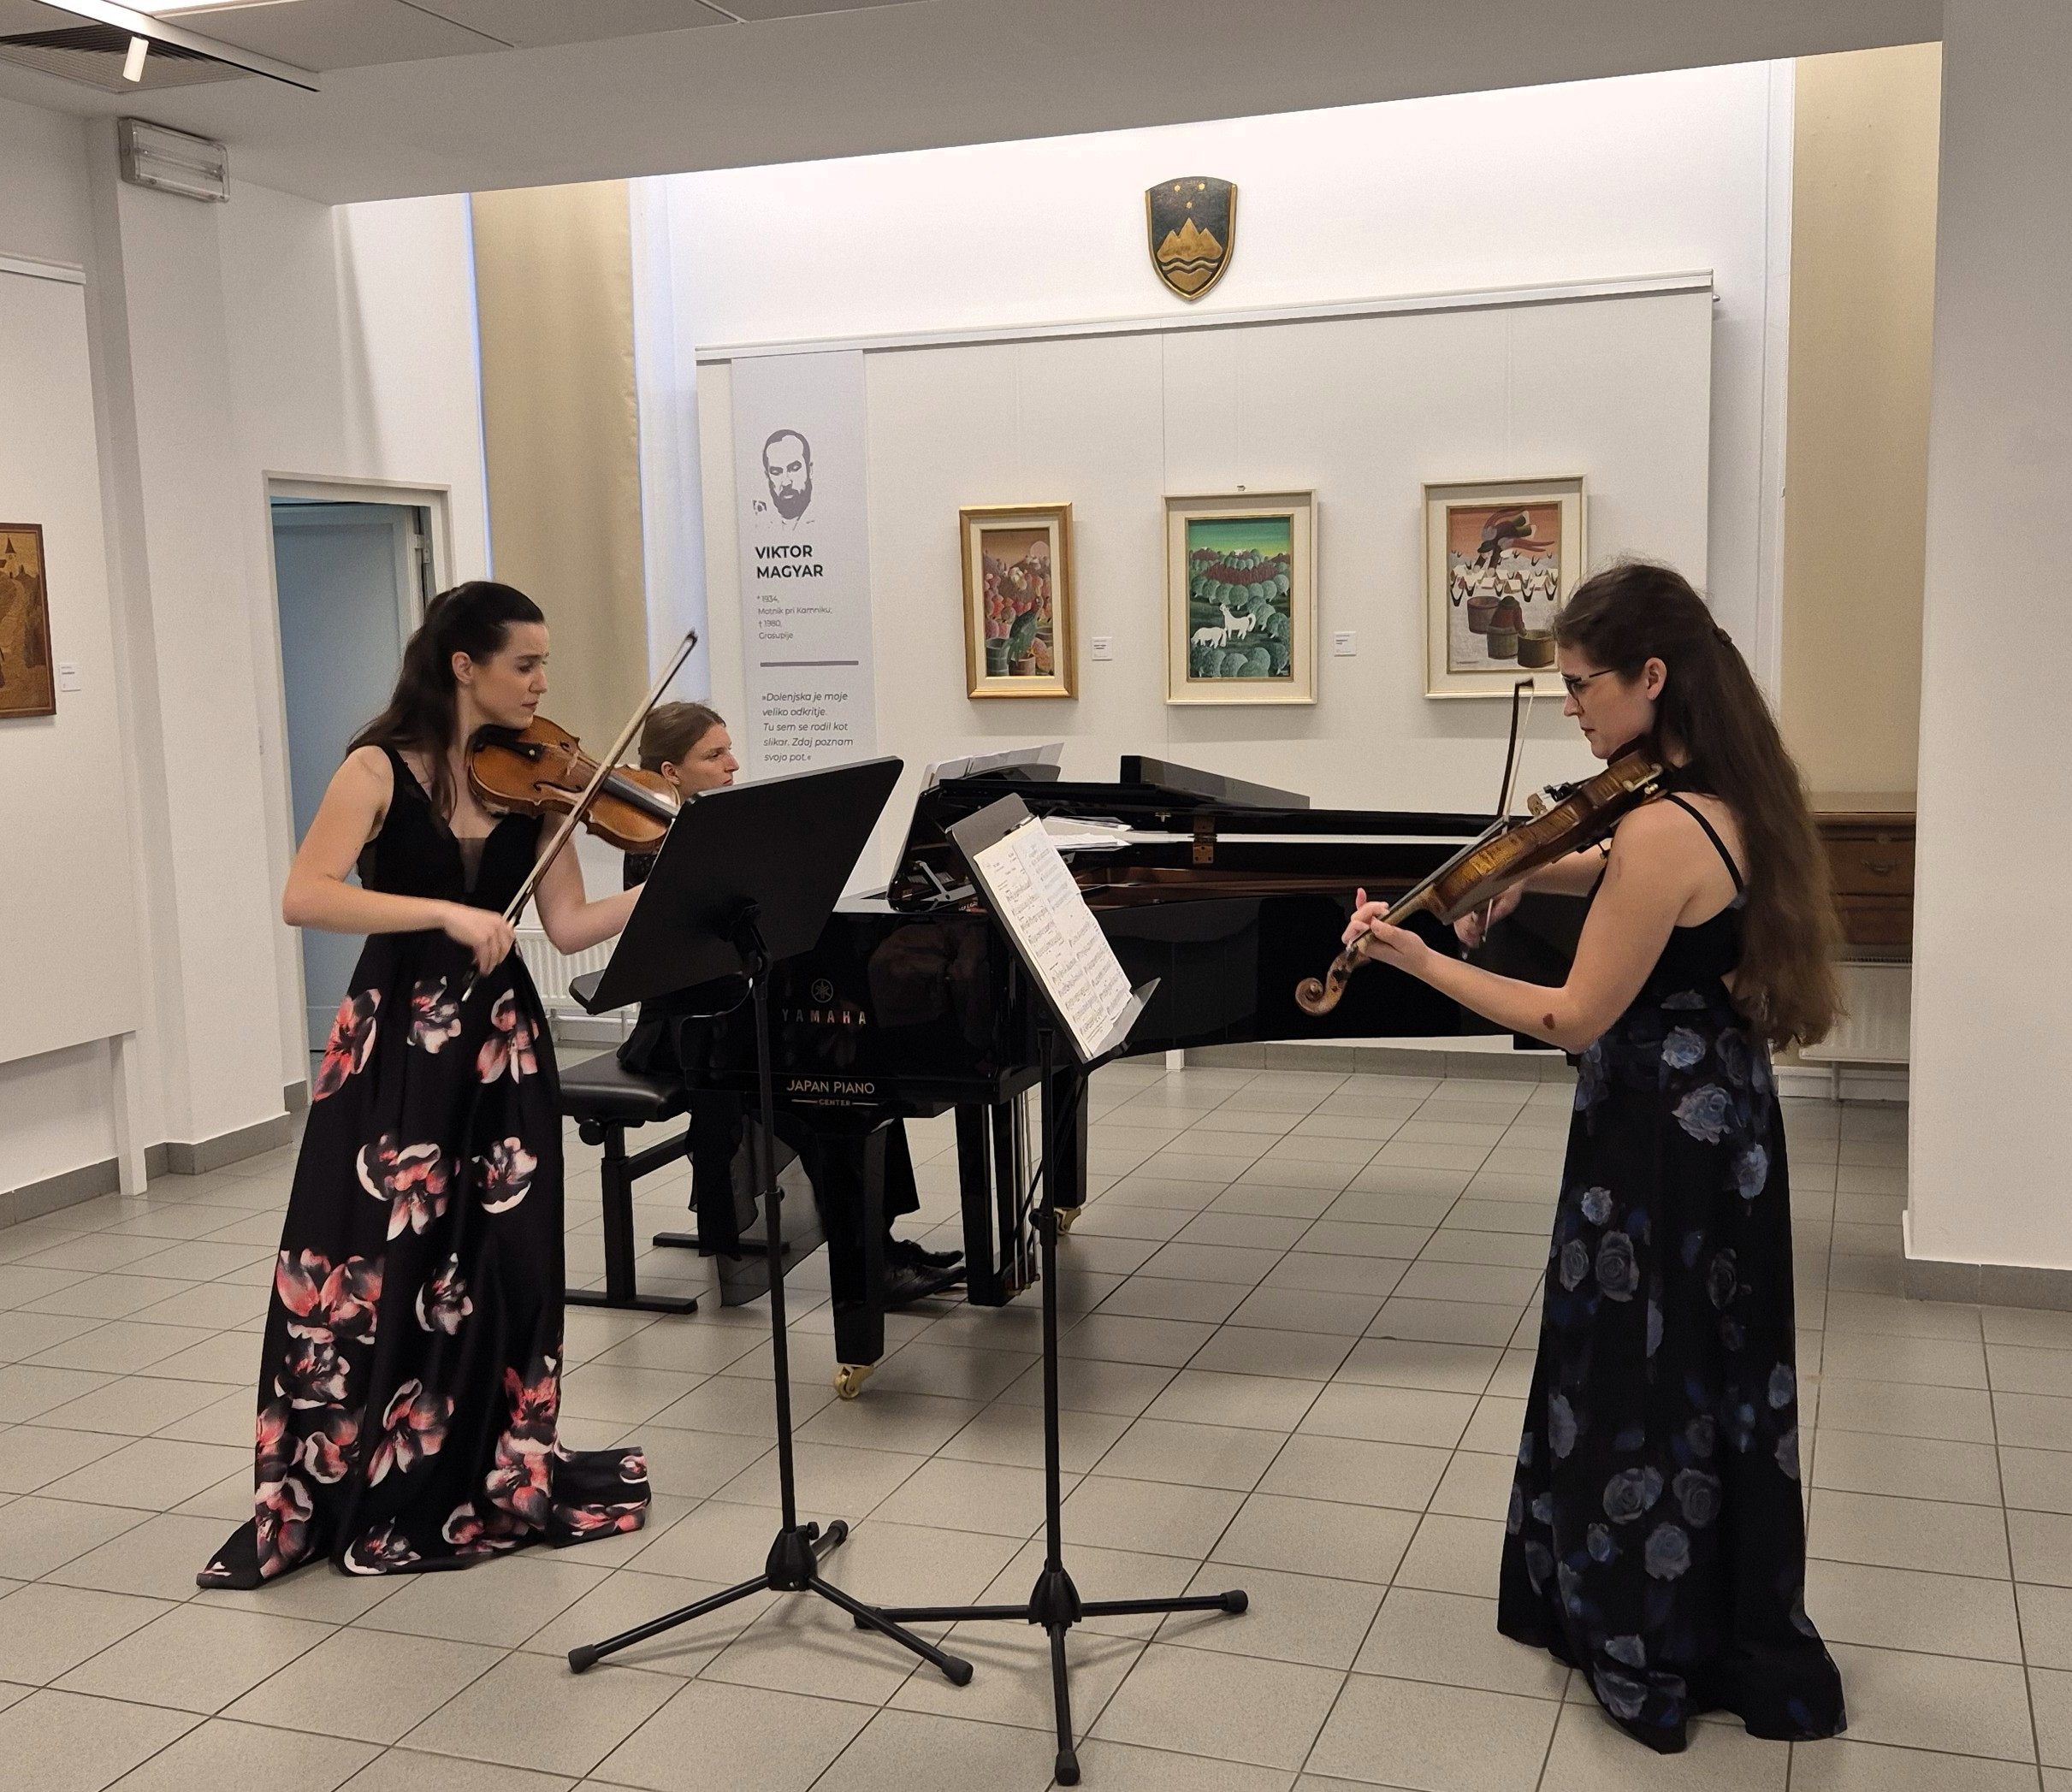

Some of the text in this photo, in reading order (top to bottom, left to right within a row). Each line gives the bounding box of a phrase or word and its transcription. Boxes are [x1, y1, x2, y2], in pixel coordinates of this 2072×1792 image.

[755, 545, 813, 559] VIKTOR
[756, 565, 824, 579] MAGYAR
[785, 606, 796, 615] pri
[813, 692, 822, 702] je
[824, 692, 849, 702] moje
[762, 707, 789, 717] veliko
[763, 723, 774, 731] Tu
[810, 722, 832, 731] rodil
[833, 721, 849, 730] kot
[763, 737, 854, 748] slikar. Zdaj poznam
[764, 753, 788, 763] svojo
[782, 1008, 867, 1025] YAMAHA
[786, 1079, 875, 1094] JAPAN PIANO
